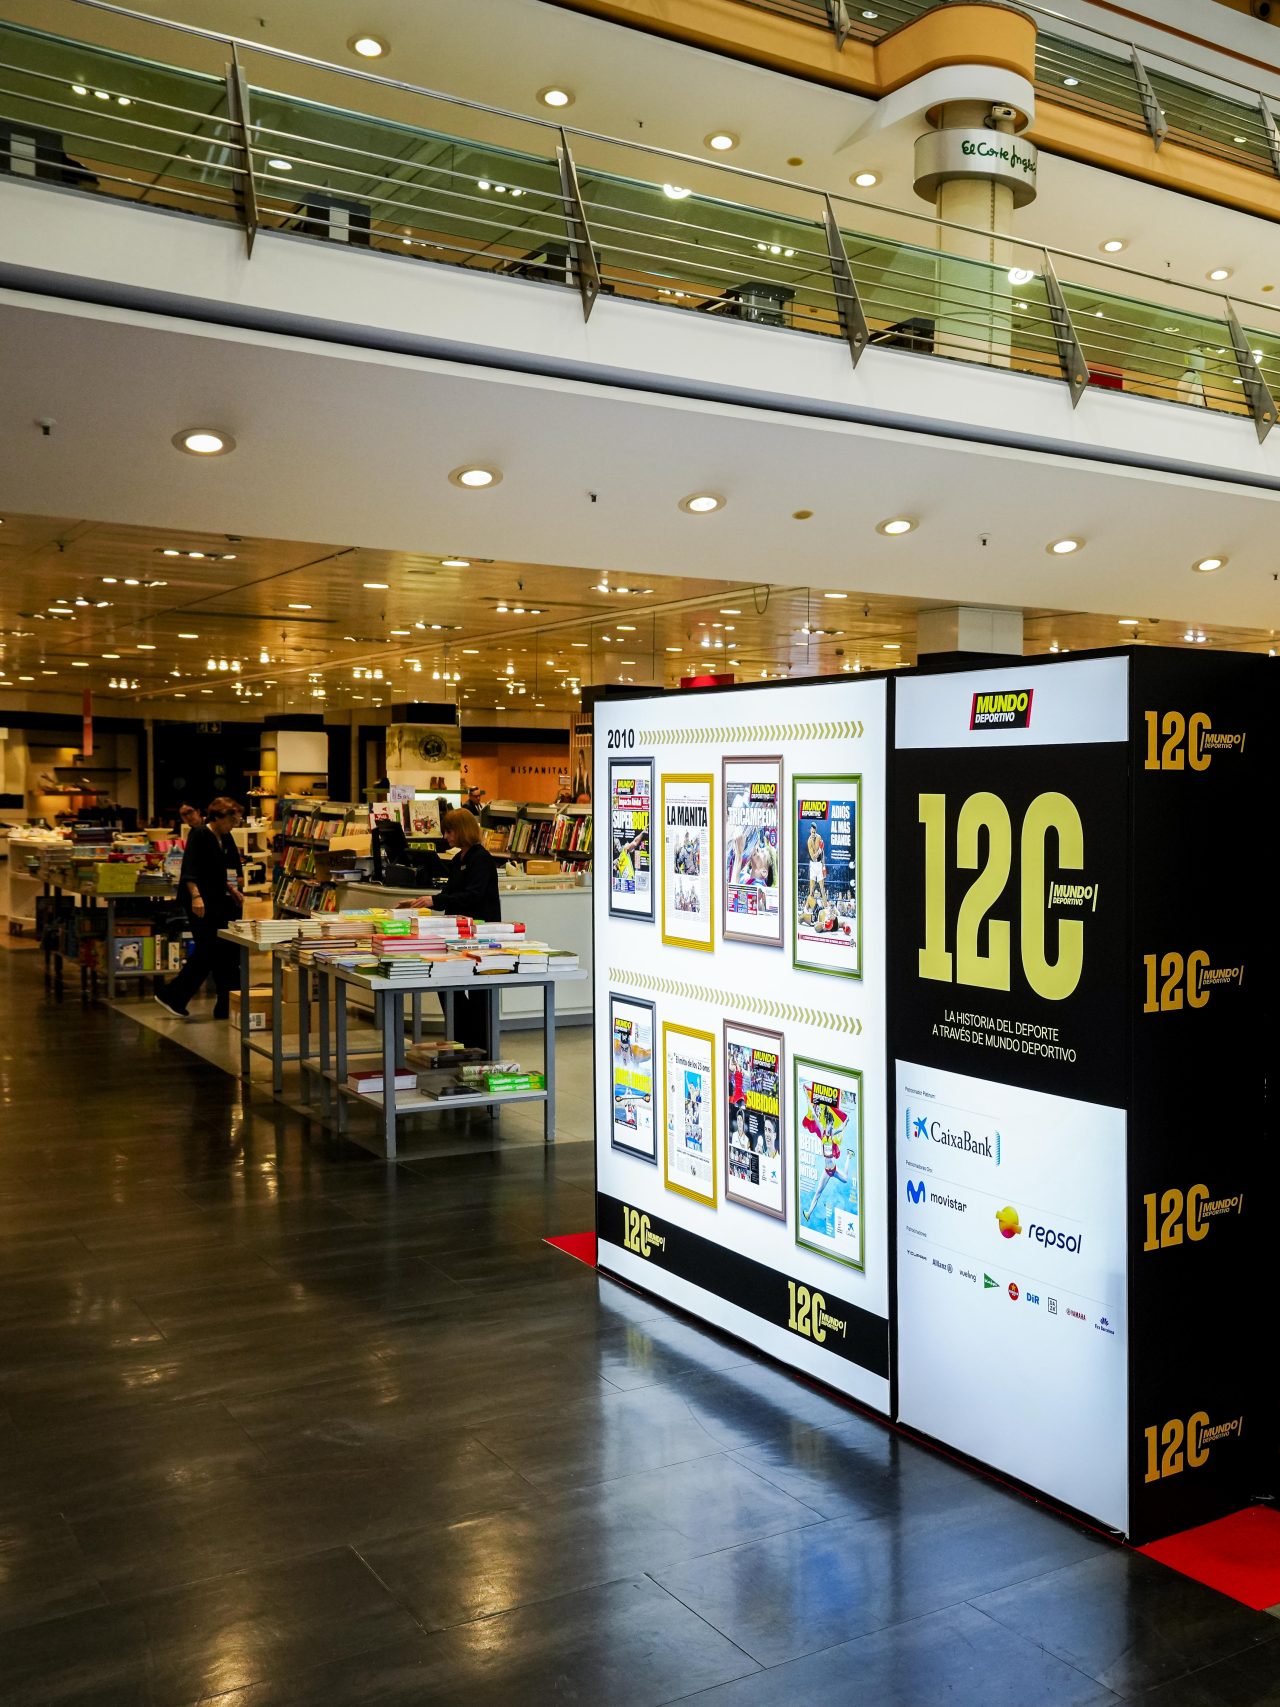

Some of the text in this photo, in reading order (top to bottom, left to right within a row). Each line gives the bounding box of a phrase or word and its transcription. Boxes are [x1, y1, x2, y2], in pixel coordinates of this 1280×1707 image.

[961, 140, 976, 156] El
[977, 142, 1009, 161] Corte
[975, 692, 1029, 713] MUNDO
[975, 711, 1016, 723] DEPORTIVO
[607, 728, 635, 749] 2010
[1204, 733, 1241, 745] MUNDO
[510, 766, 568, 775] HISPANITAS
[751, 783, 776, 795] MUNDO
[802, 801, 827, 812] MUNDO
[666, 805, 708, 827] LA MANITA
[1052, 883, 1093, 900] MUNDO
[1052, 896, 1084, 906] DEPORTIVO
[1202, 977, 1231, 985] DEPORTIVO
[1203, 967, 1240, 980] MUNDO
[944, 1009, 1060, 1042] LA HISTORIA DEL DEPORTE
[932, 1023, 1077, 1063] A TRAVÉS DE MUNDO DEPORTIVO
[753, 1050, 777, 1064] MUNDO
[813, 1083, 839, 1099] MUNDO
[930, 1121, 993, 1158] CaixaBank
[930, 1192, 967, 1213] movistar
[1202, 1196, 1239, 1213] MUNDO
[1202, 1207, 1230, 1218] DEPORTIVO
[1028, 1223, 1082, 1254] repsol
[821, 1312, 844, 1330] MUNDO
[1202, 1419, 1239, 1440] MUNDO
[1202, 1431, 1230, 1444] DEPORTIVO
